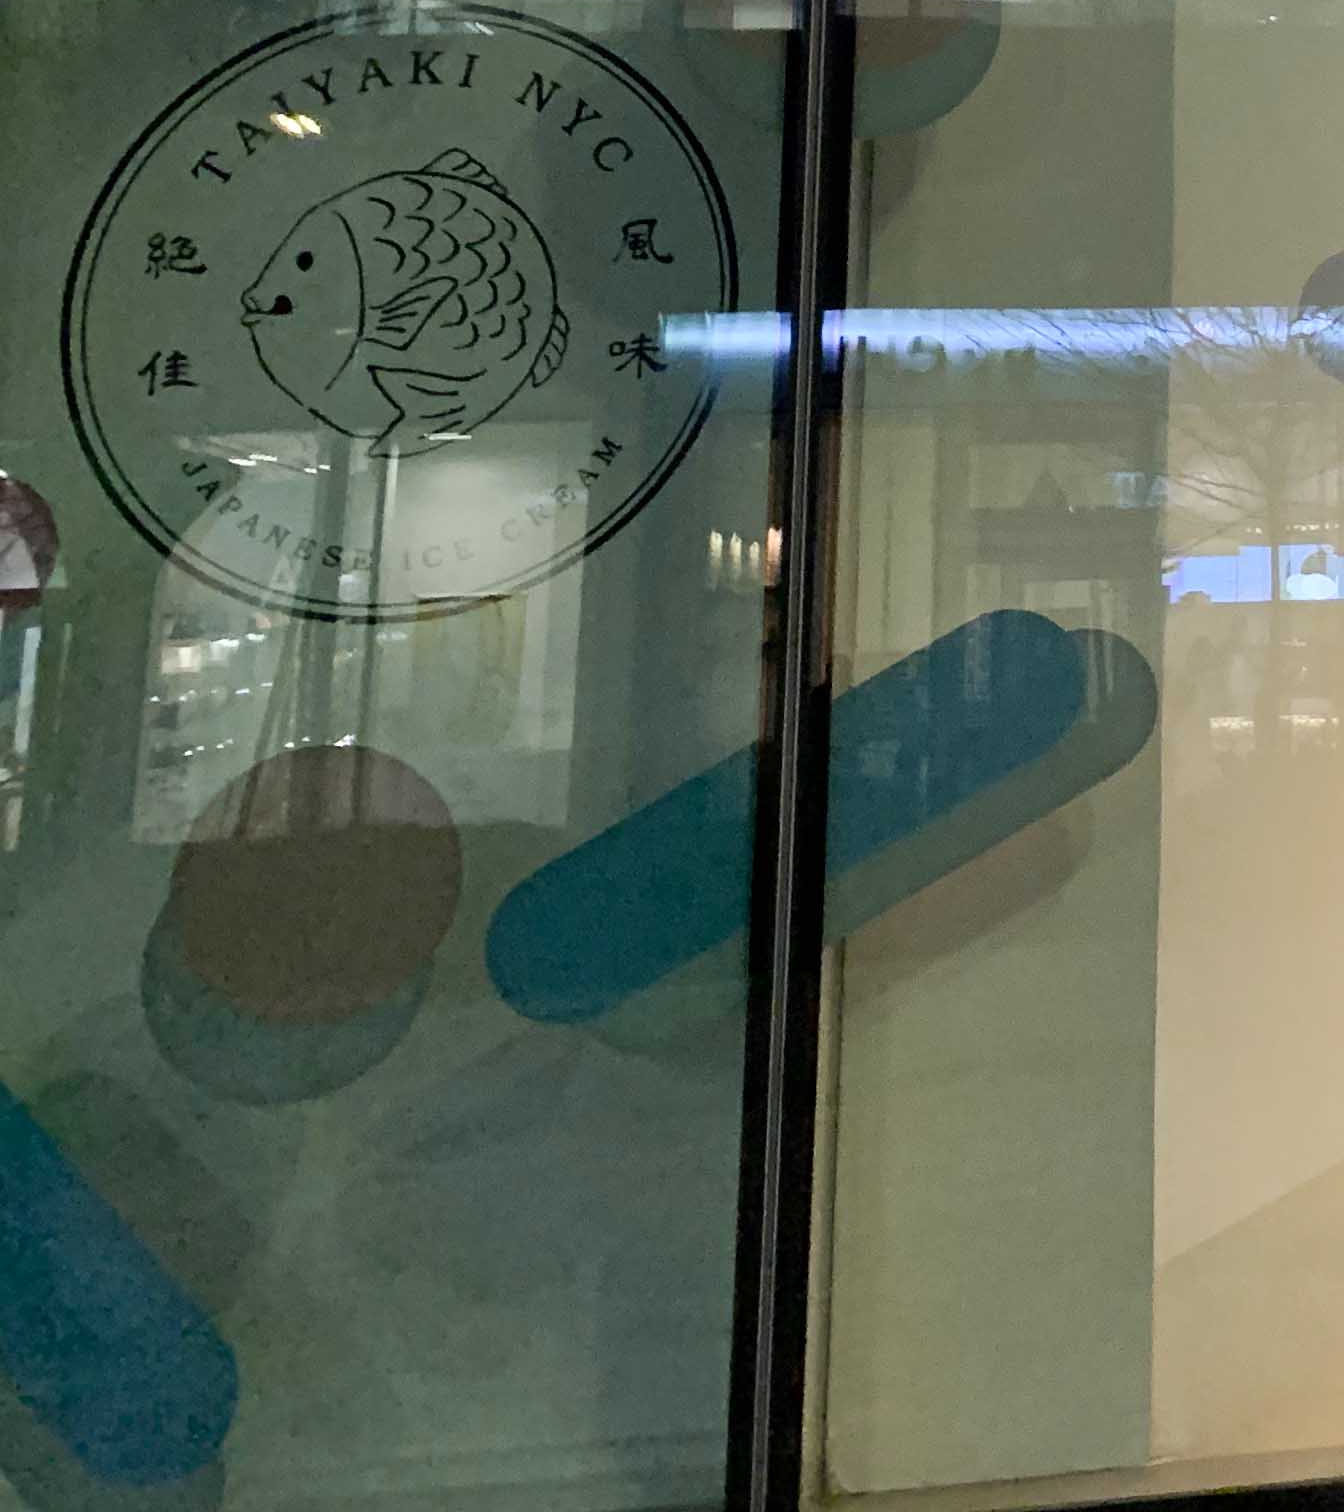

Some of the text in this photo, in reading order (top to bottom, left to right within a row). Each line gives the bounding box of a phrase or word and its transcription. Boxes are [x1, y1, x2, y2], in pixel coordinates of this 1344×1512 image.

[191, 50, 634, 184] TAIYAKI NYC
[181, 435, 625, 573] JAPANESE ICE CREAM
